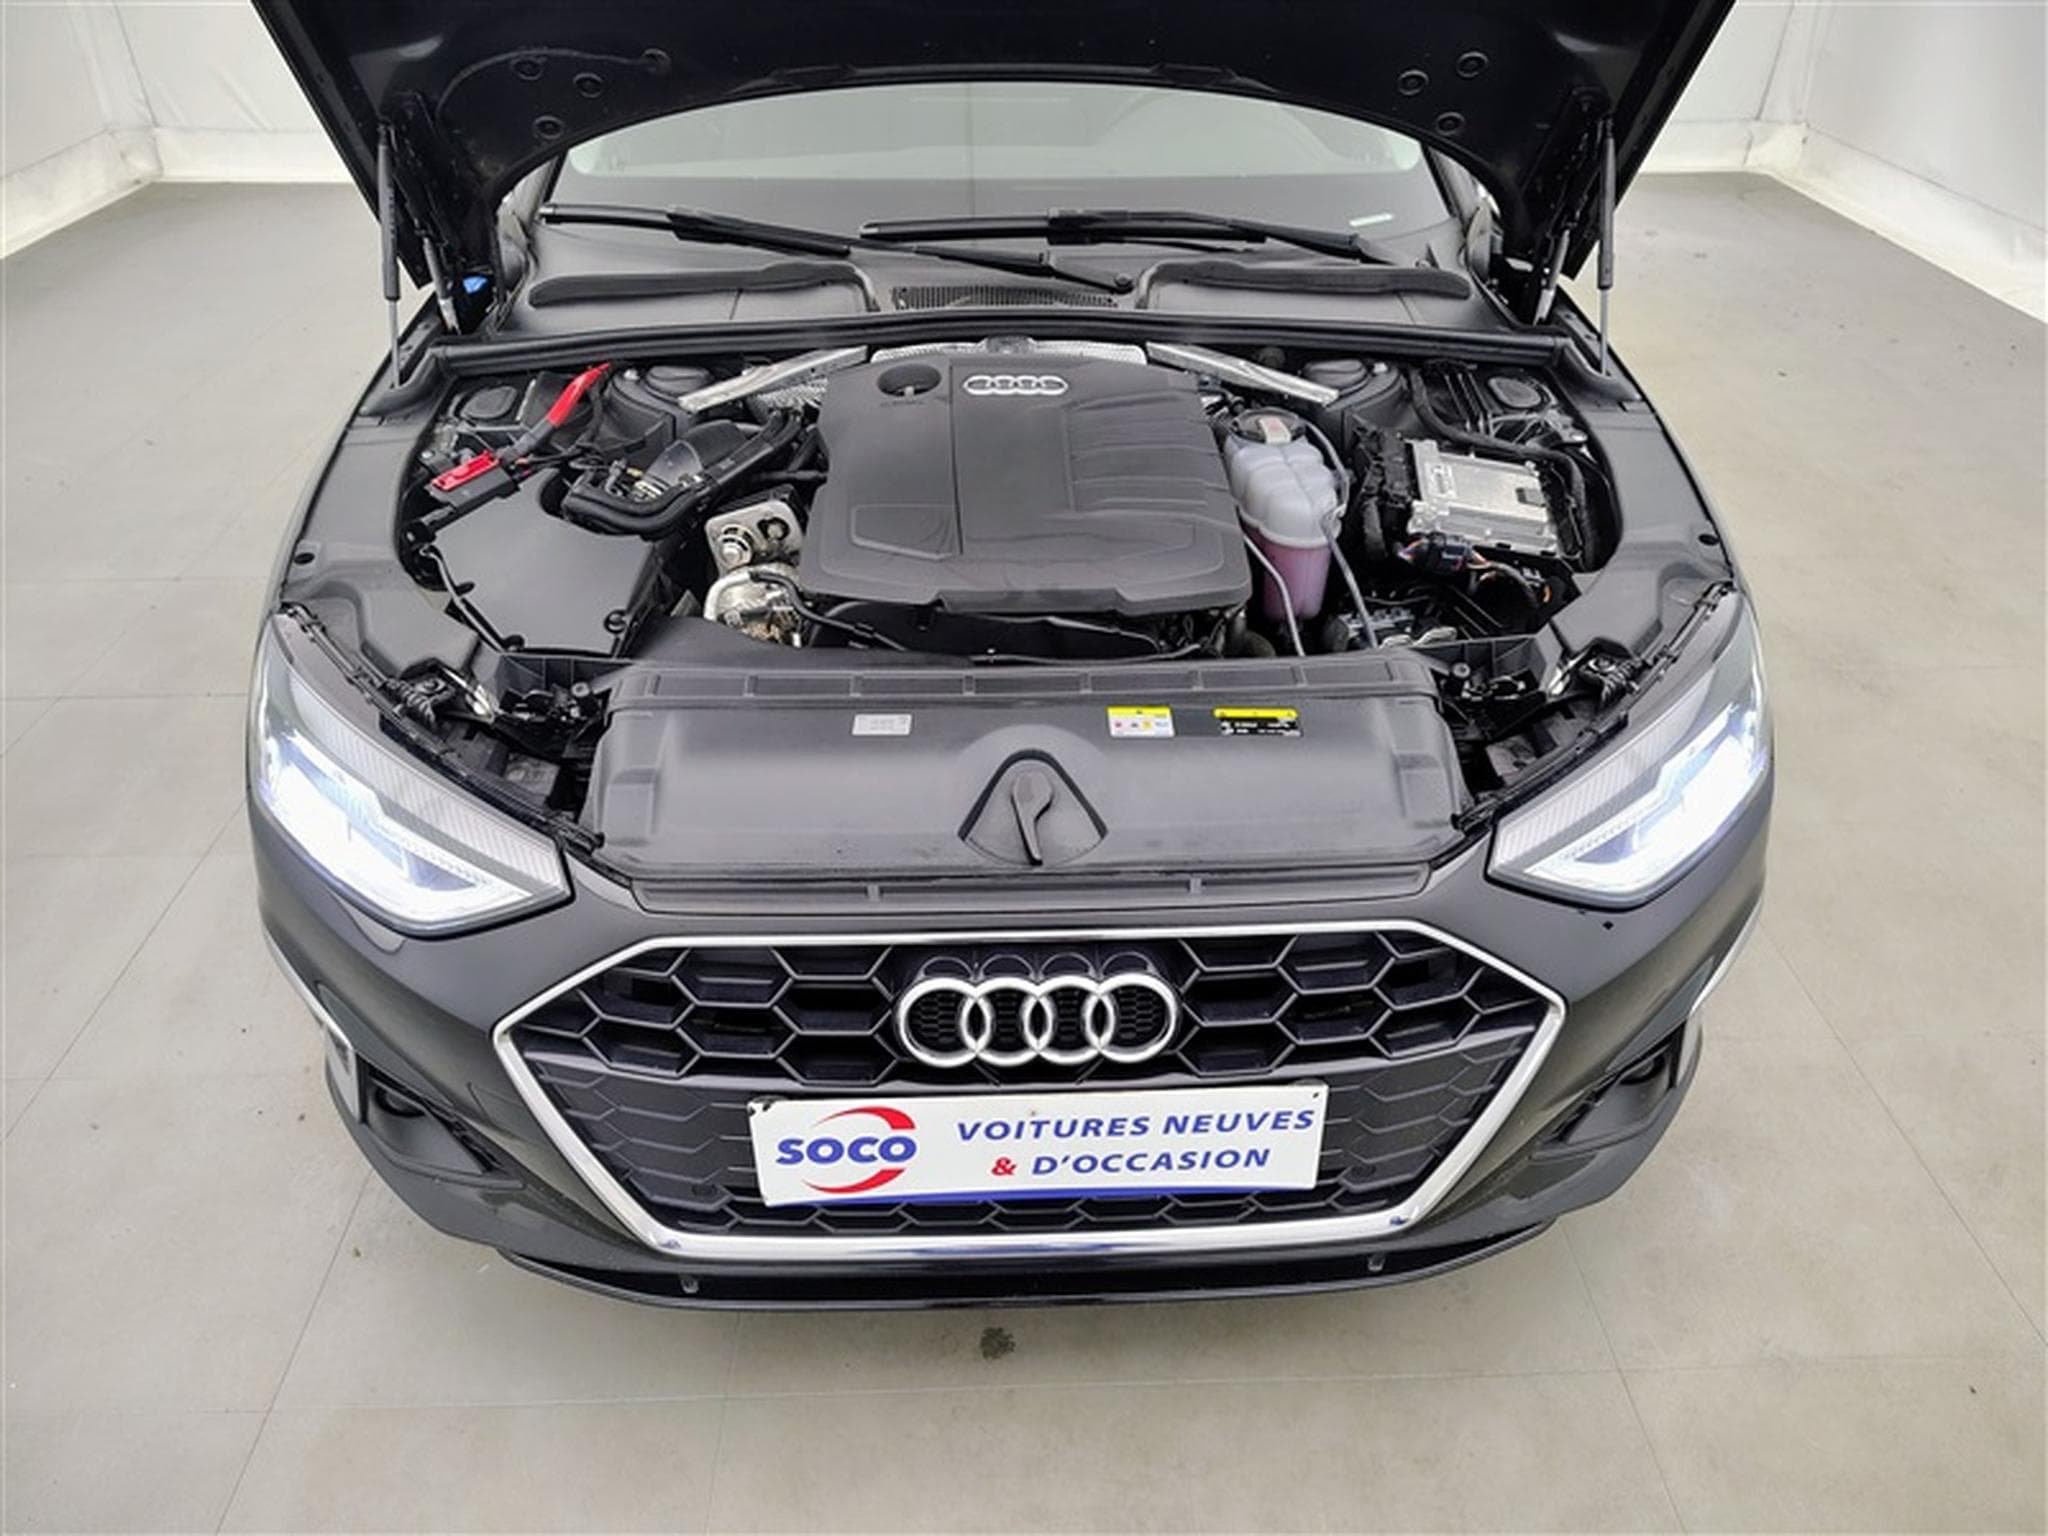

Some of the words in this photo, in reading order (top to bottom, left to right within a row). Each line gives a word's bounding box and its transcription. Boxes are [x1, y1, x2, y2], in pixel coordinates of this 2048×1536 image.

[957, 1116, 1149, 1142] VOITURES
[1163, 1109, 1315, 1136] NEUVES
[776, 1136, 917, 1165] SOCO
[991, 1157, 1016, 1177] &
[1031, 1148, 1270, 1176] D'OCCASION
